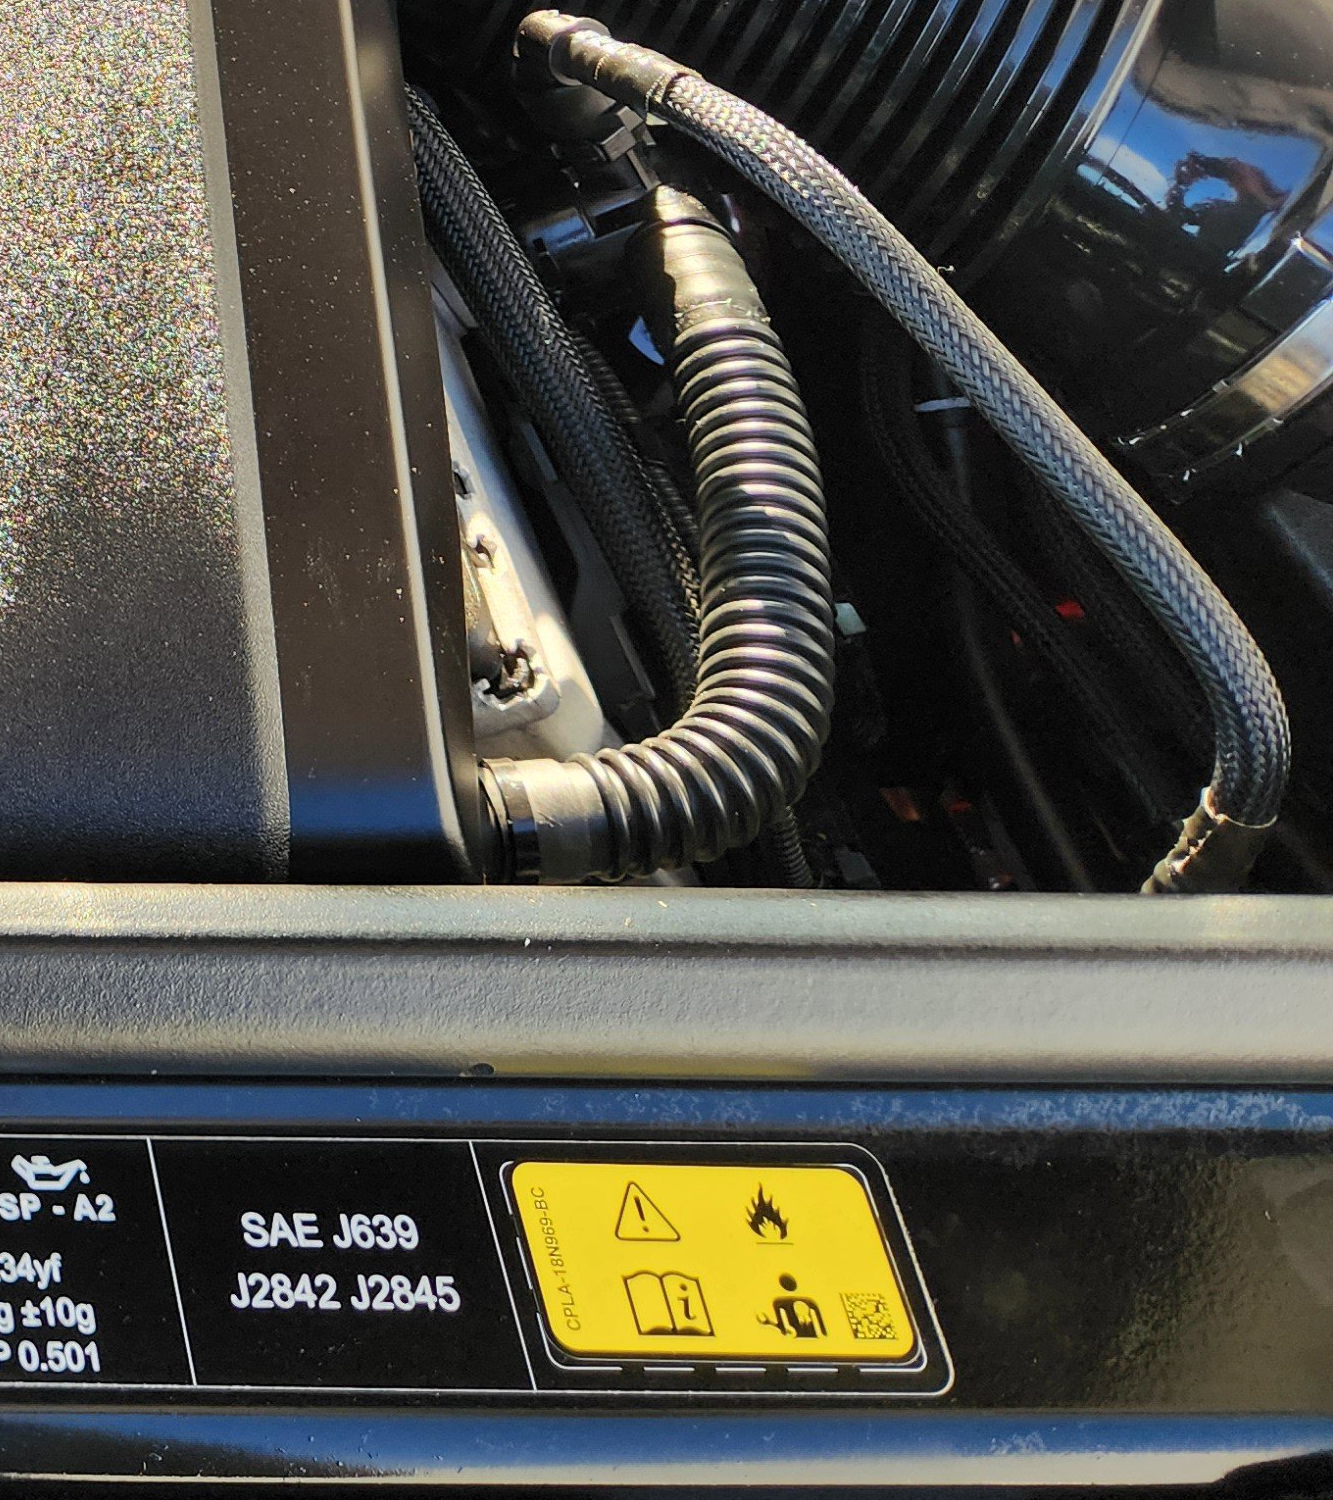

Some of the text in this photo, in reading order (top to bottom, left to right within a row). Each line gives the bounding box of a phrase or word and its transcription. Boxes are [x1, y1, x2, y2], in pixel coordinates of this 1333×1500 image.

[73, 1193, 117, 1222] A2
[240, 1211, 419, 1251] SAE J639
[530, 1186, 581, 1331] CPLA-18N969-BC
[230, 1271, 461, 1313] J2842 J2845
[20, 1296, 97, 1335] ±10g
[17, 1339, 101, 1373] 0.501
